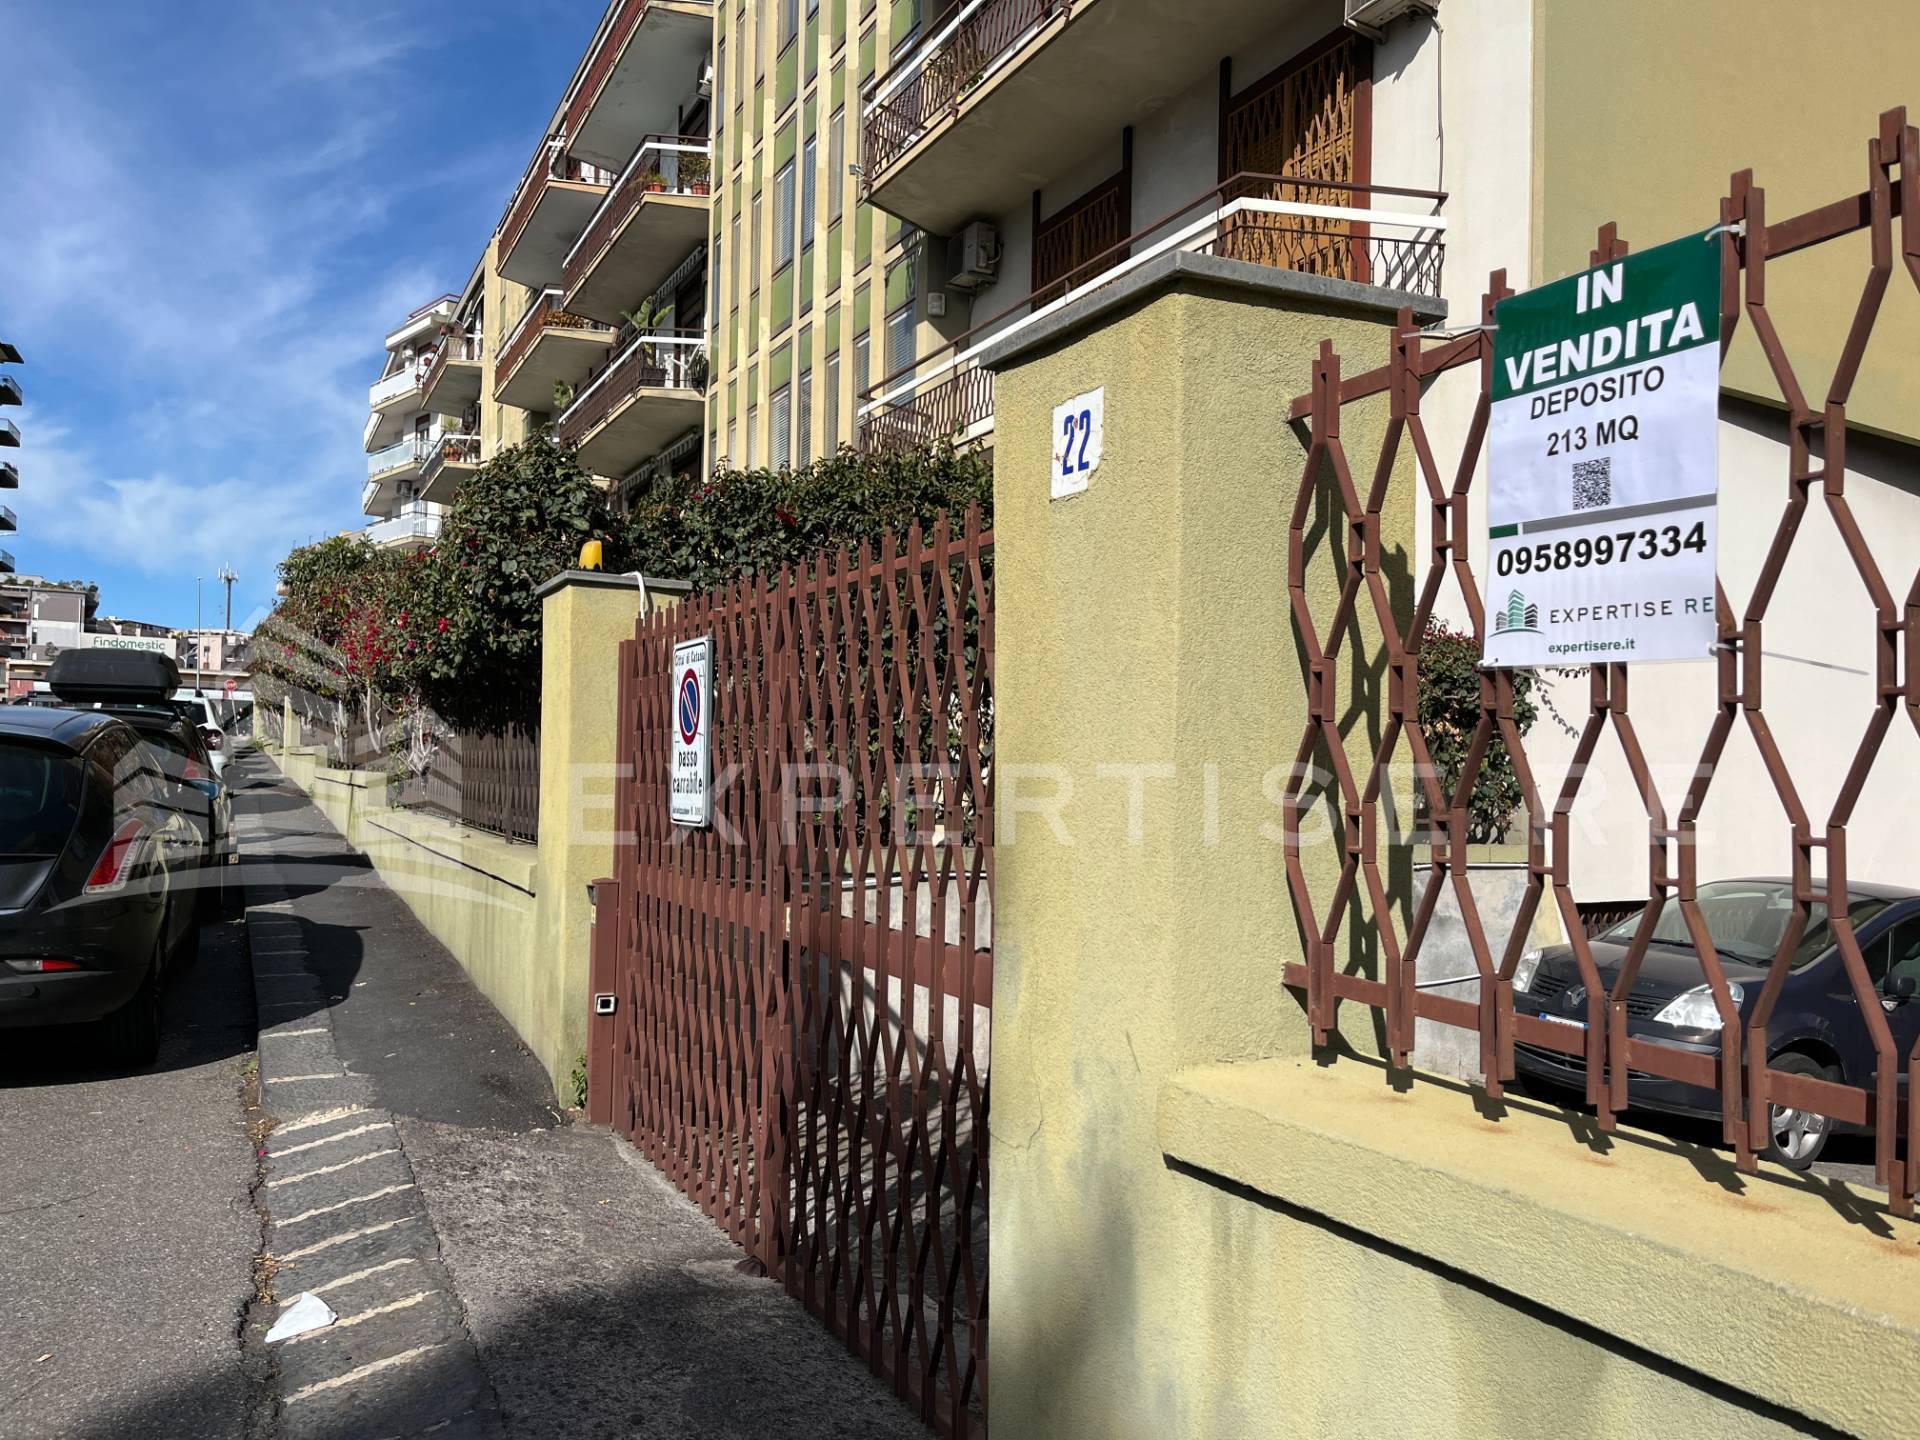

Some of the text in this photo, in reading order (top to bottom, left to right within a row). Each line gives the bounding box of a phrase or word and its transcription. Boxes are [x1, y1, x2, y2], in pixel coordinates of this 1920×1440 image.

[1575, 263, 1624, 315] IN
[1505, 302, 1704, 391] VENDITA
[1530, 365, 1665, 420] DEPOSITO
[1062, 409, 1091, 476] 22
[1547, 414, 1639, 457] 213 MQ
[1497, 521, 1707, 577] 0958997334
[1550, 597, 1715, 625] EXPERTISE RE
[1548, 638, 1636, 656] expertisere.it
[673, 771, 702, 794] carrabile
[679, 751, 698, 771] passo
